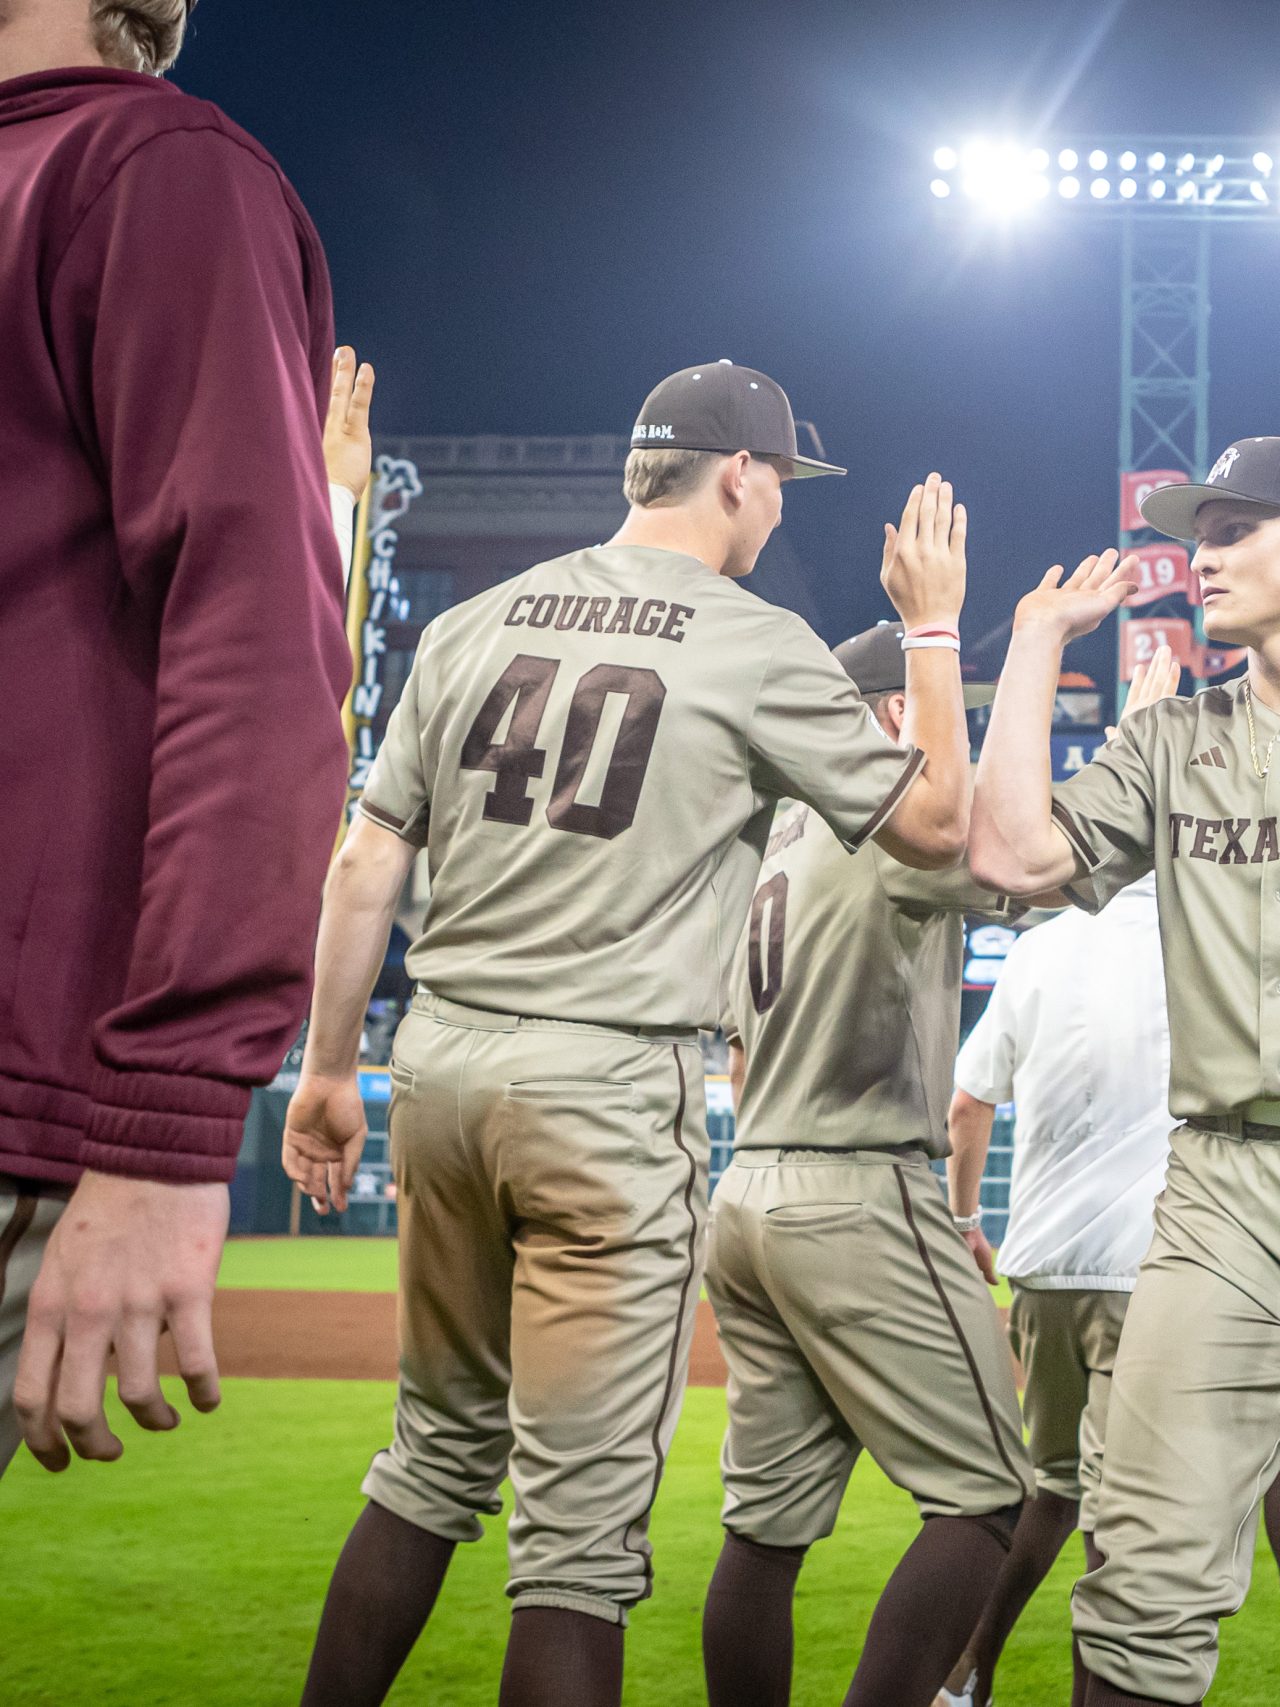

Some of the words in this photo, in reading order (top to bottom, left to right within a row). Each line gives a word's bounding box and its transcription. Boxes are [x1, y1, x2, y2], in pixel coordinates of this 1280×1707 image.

[1139, 557, 1176, 586] 19
[504, 593, 696, 643] COURAGE
[459, 653, 667, 840] 40
